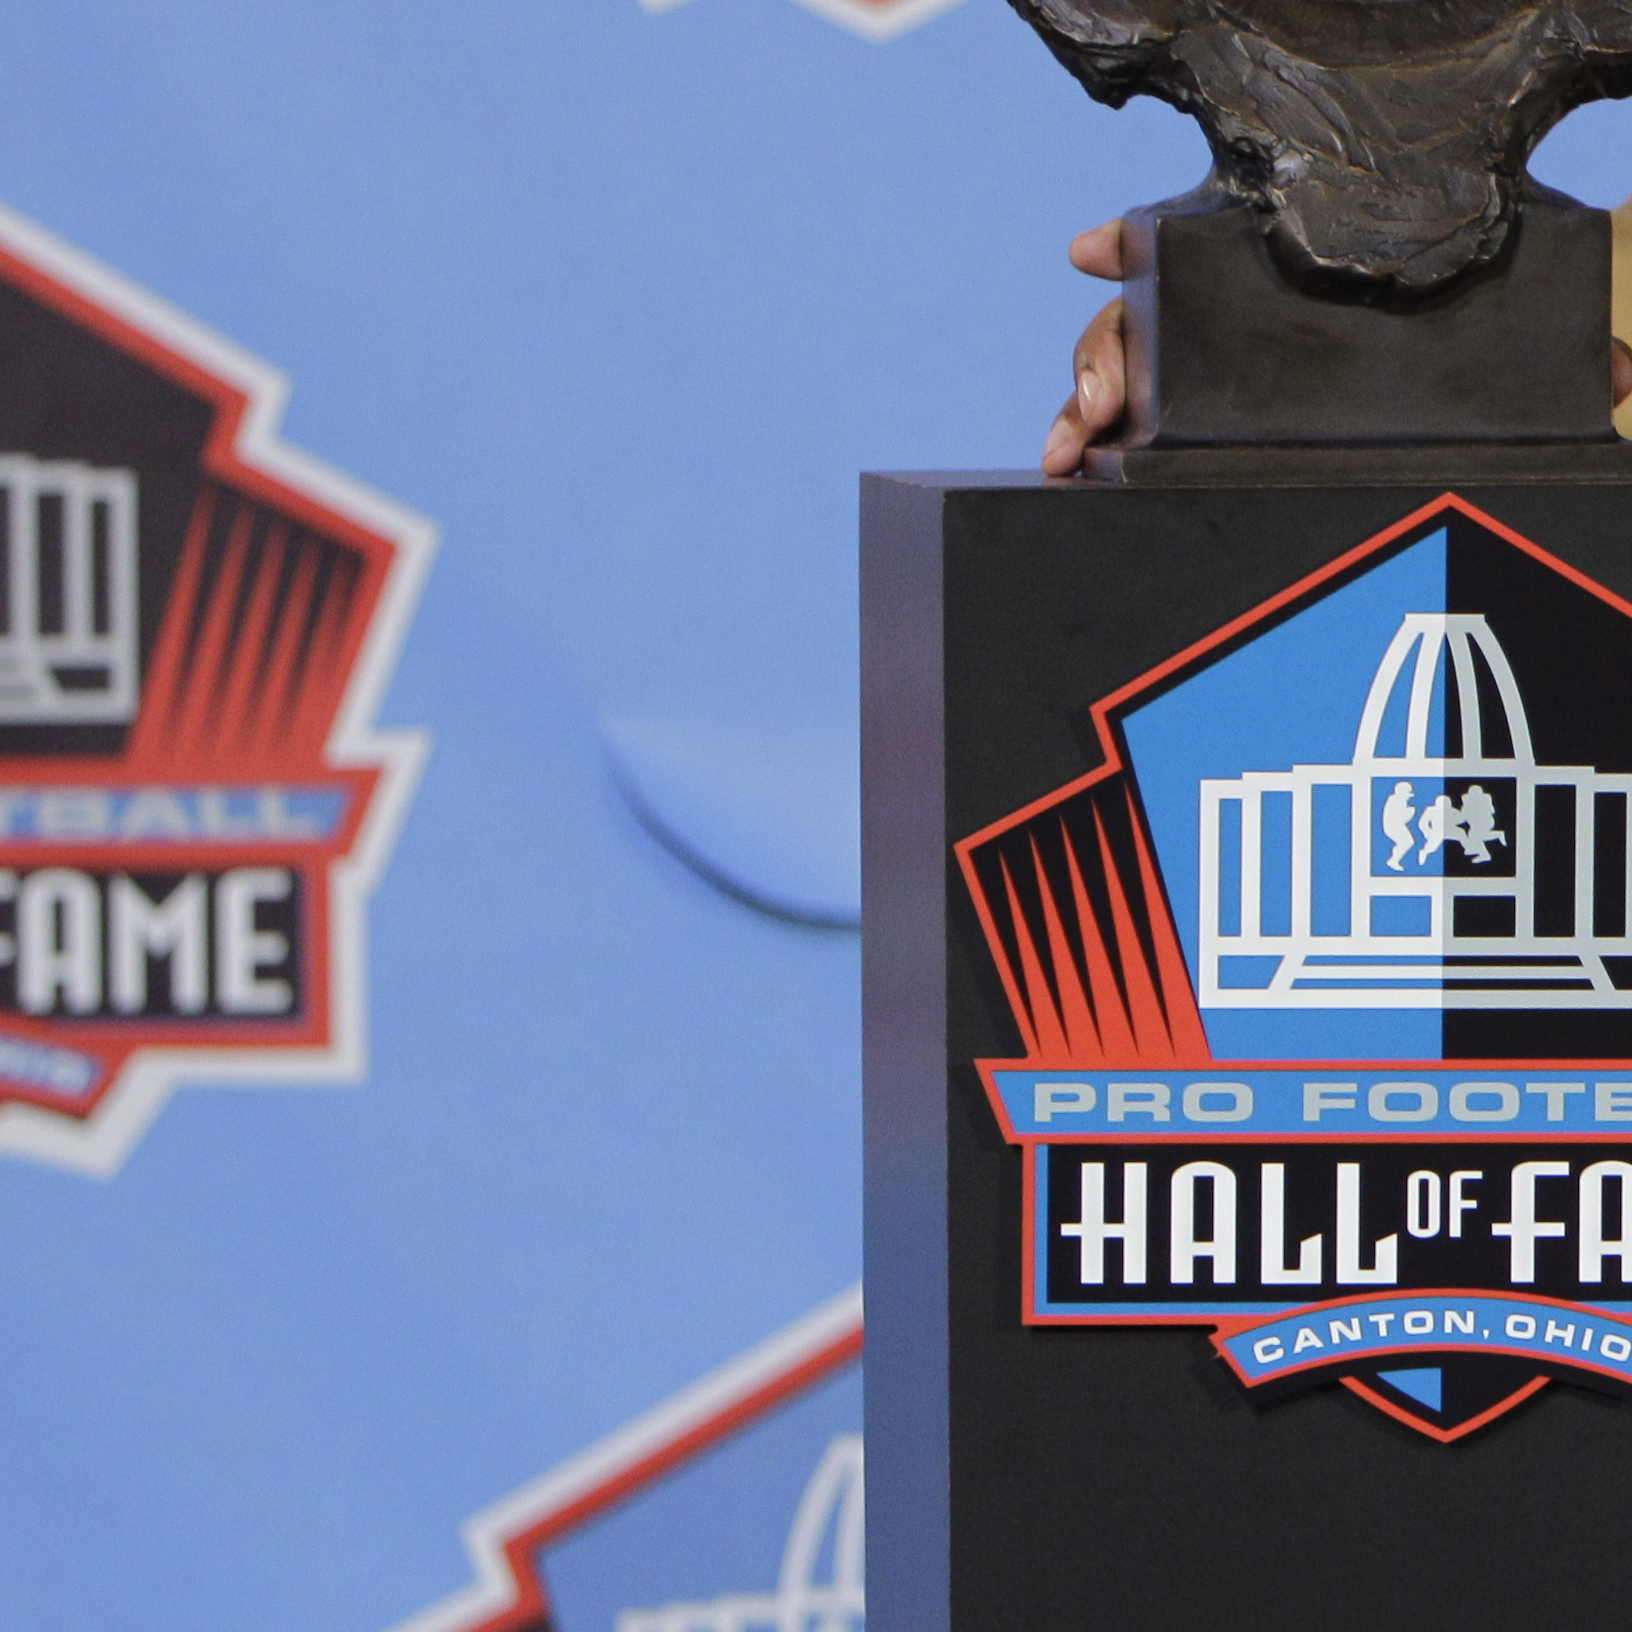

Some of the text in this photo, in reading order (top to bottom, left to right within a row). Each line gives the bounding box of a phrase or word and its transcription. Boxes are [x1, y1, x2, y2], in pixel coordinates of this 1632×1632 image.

[0, 868, 294, 1015] AME
[1033, 1082, 1254, 1122] PRO
[1061, 1161, 1398, 1285] HALL
[1407, 1170, 1483, 1239] OF
[1252, 1310, 1632, 1364] CANTON, OHIO
